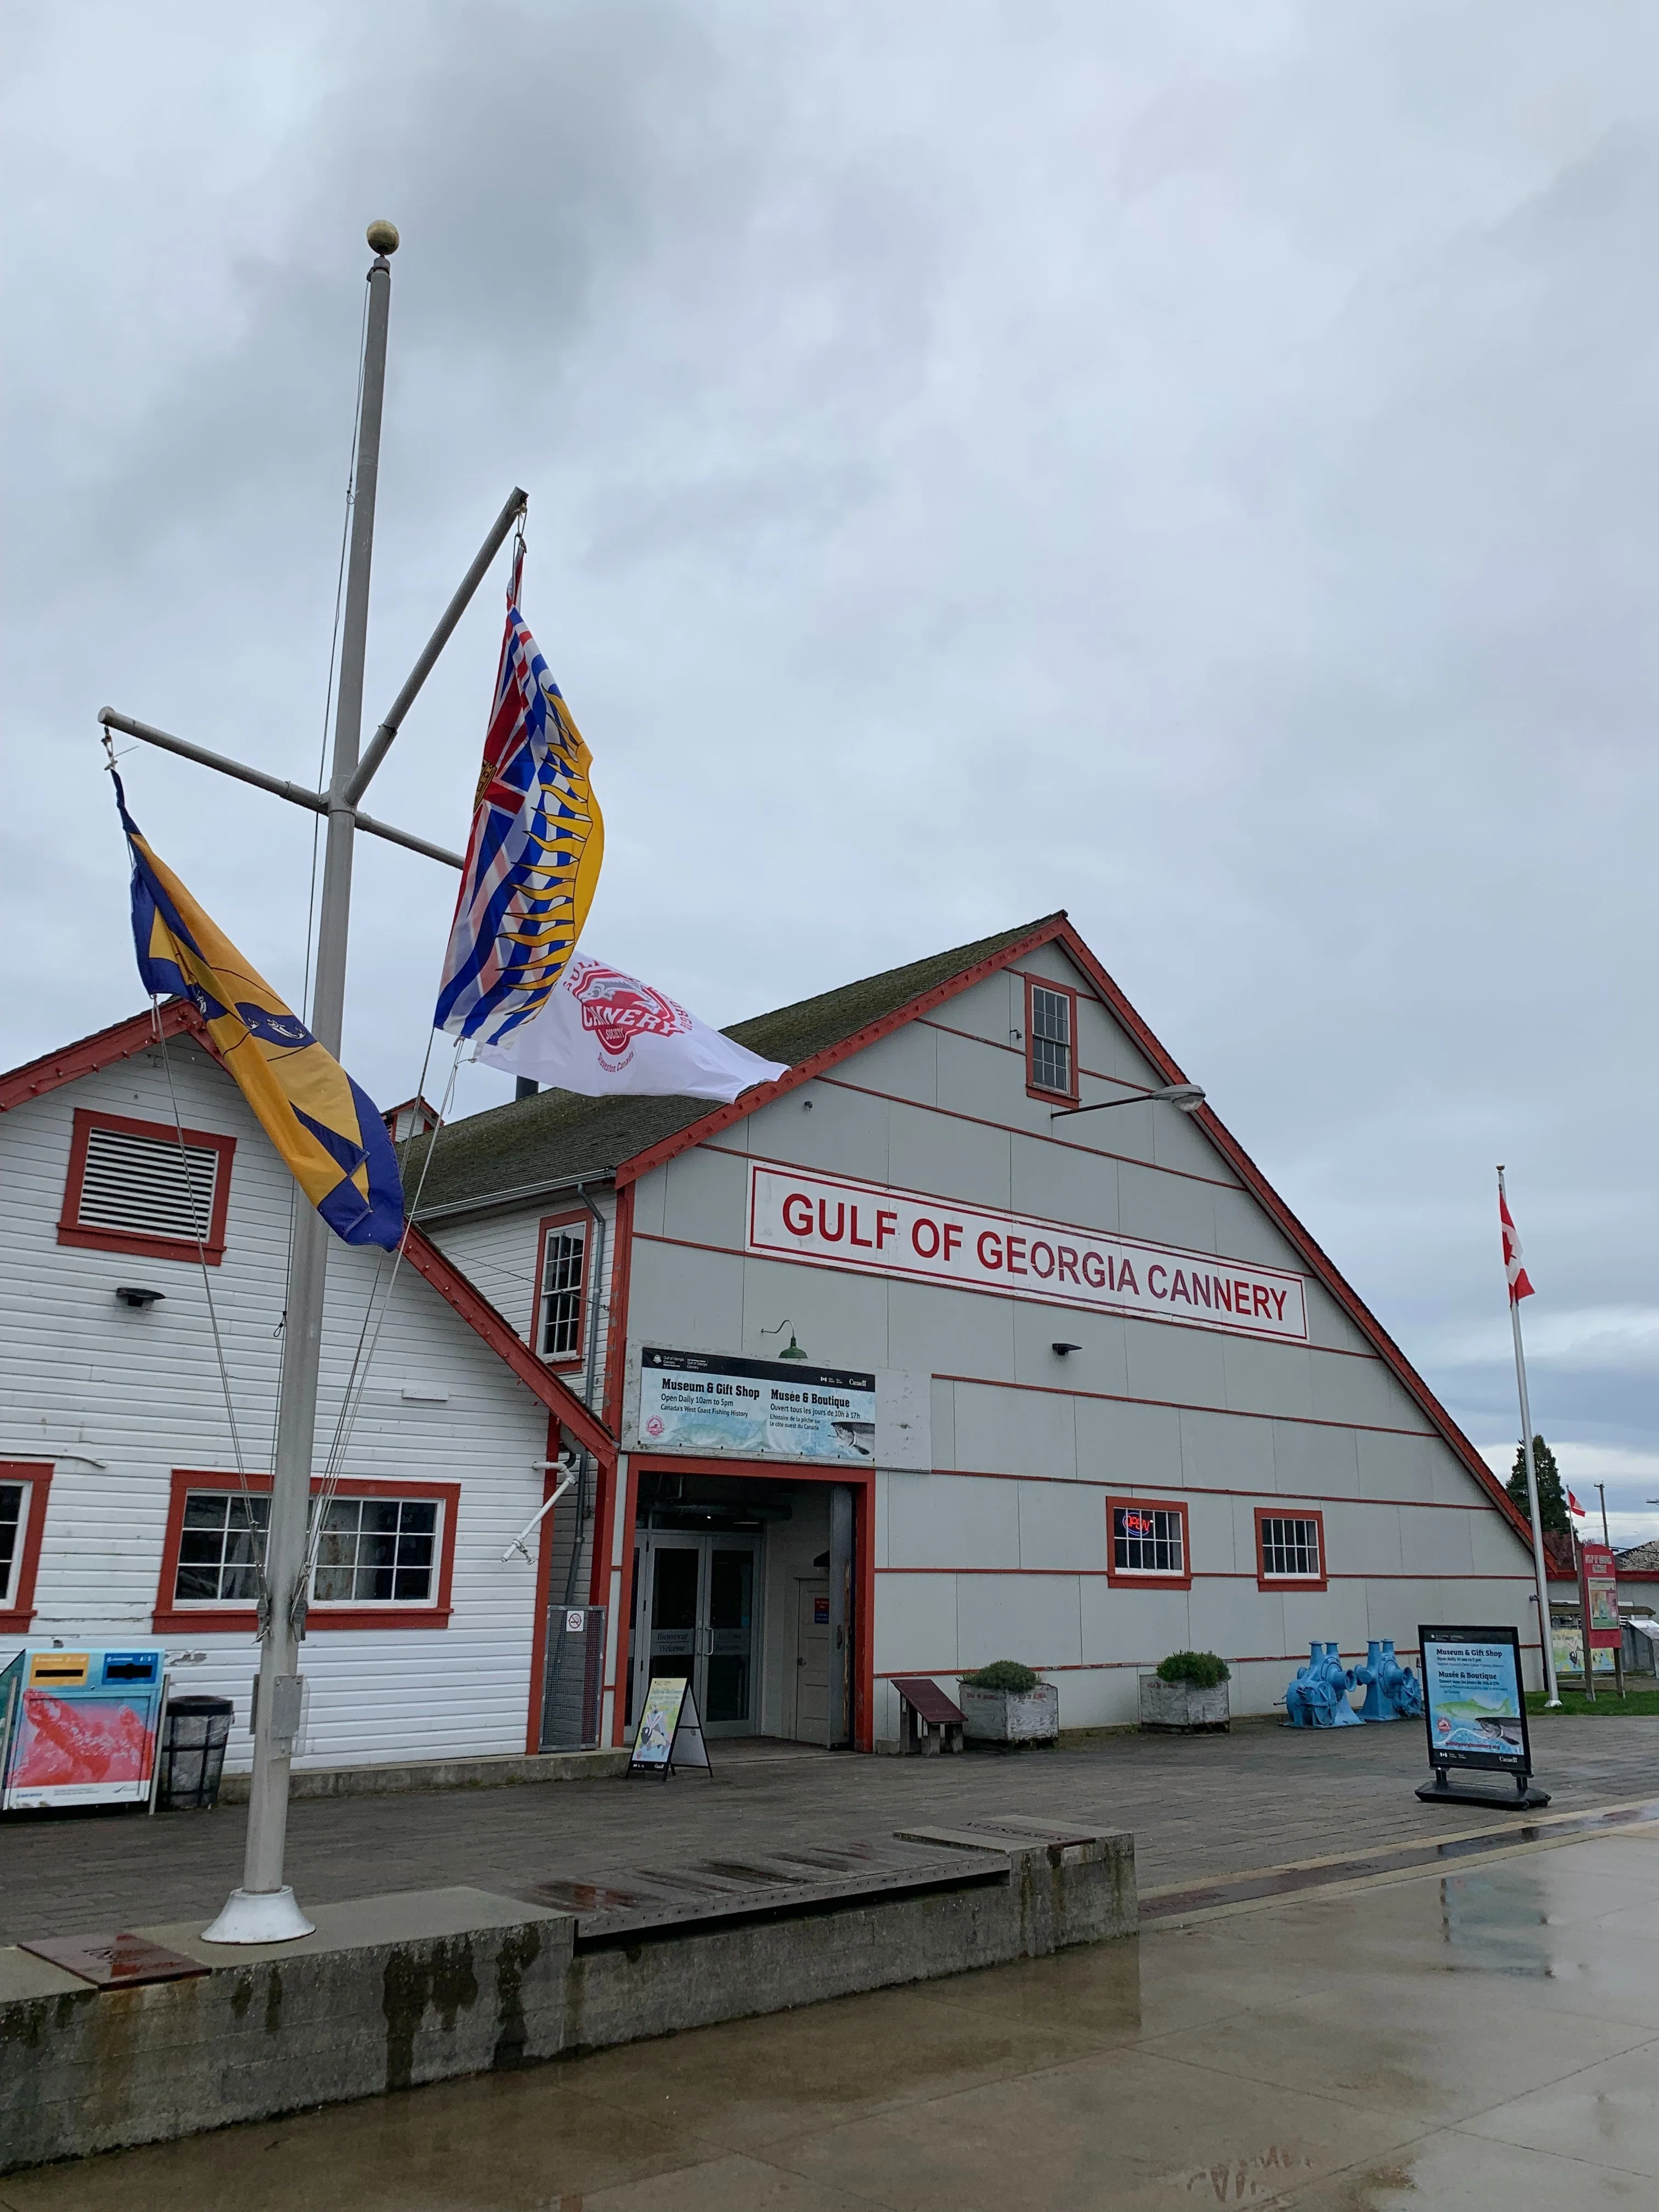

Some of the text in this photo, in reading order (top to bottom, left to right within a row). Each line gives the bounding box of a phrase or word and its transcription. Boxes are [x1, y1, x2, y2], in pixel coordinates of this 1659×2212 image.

[606, 1028, 625, 1040] SOCIETY
[617, 1051, 634, 1071] Canada
[783, 1193, 1286, 1321] GULF OF GEORGIA CANNERY
[662, 1378, 760, 1400] Museum & Gift Shop
[661, 1394, 677, 1402] Open
[679, 1395, 694, 1404] Daily
[721, 1399, 733, 1407] 5pm
[771, 1389, 850, 1409] Musée & Boutique
[713, 1408, 730, 1417] Fishing
[731, 1410, 748, 1418] History
[770, 1403, 789, 1412] Ouvert
[812, 1408, 826, 1416] jours
[1124, 1515, 1150, 1531] OPEN
[1466, 1672, 1497, 1680] Boutique
